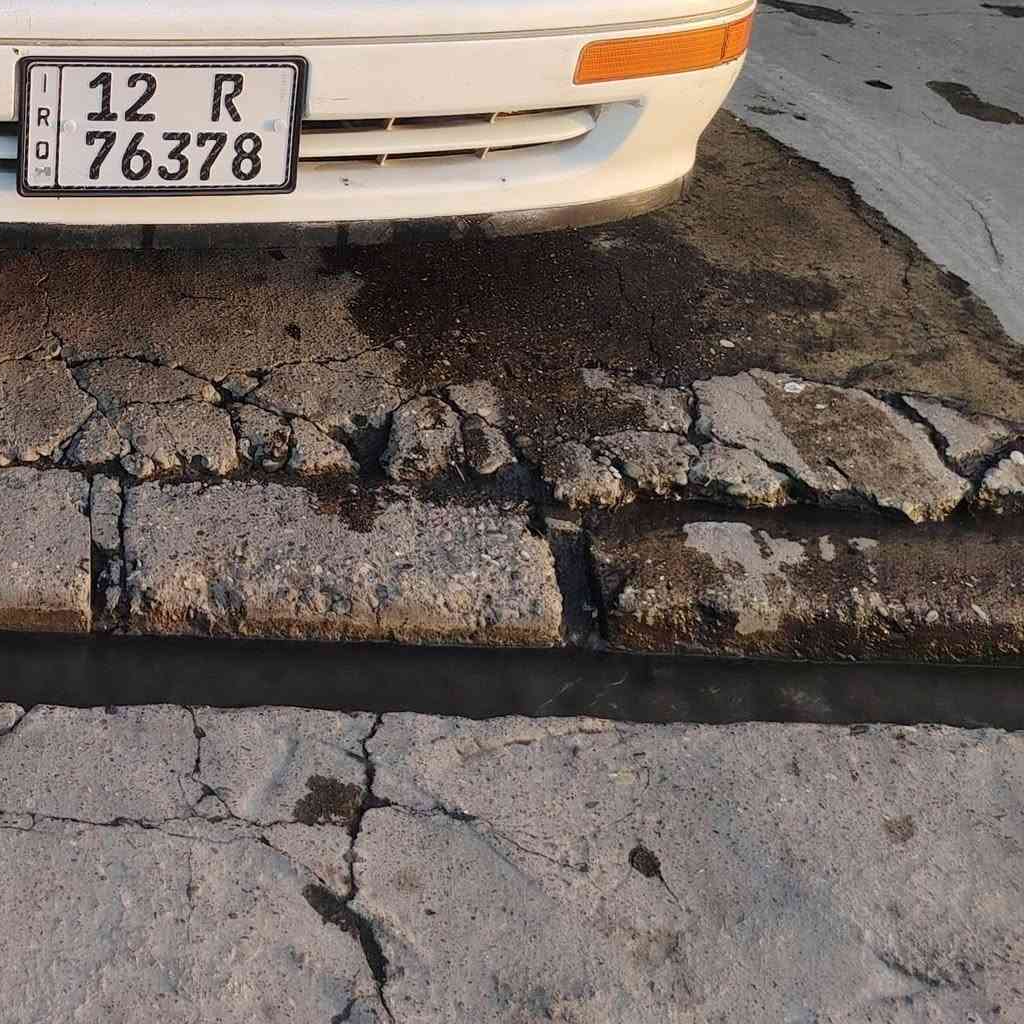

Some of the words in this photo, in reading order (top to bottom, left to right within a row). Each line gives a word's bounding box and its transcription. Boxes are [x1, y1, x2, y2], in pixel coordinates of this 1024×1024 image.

[86, 71, 158, 123] 12
[211, 72, 244, 123] R
[84, 130, 263, 182] 76378
